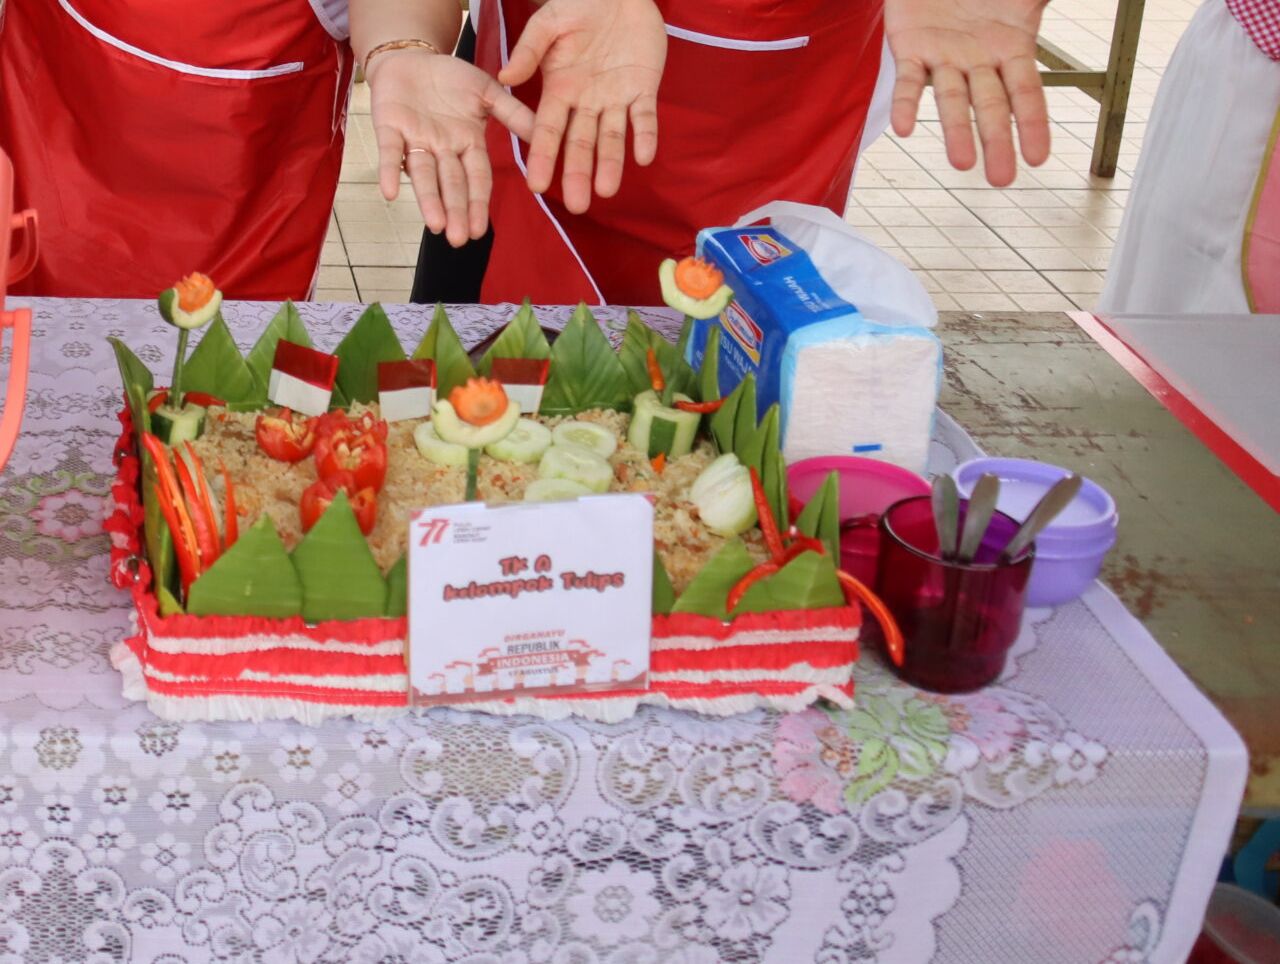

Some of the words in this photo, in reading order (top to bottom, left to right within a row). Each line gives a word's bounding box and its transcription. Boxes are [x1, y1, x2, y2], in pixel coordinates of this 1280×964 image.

[418, 518, 449, 547] 77
[534, 554, 552, 573] A
[560, 571, 625, 592] Tulips
[507, 641, 560, 655] REPUBLIK
[496, 652, 568, 669] INDONESIA
